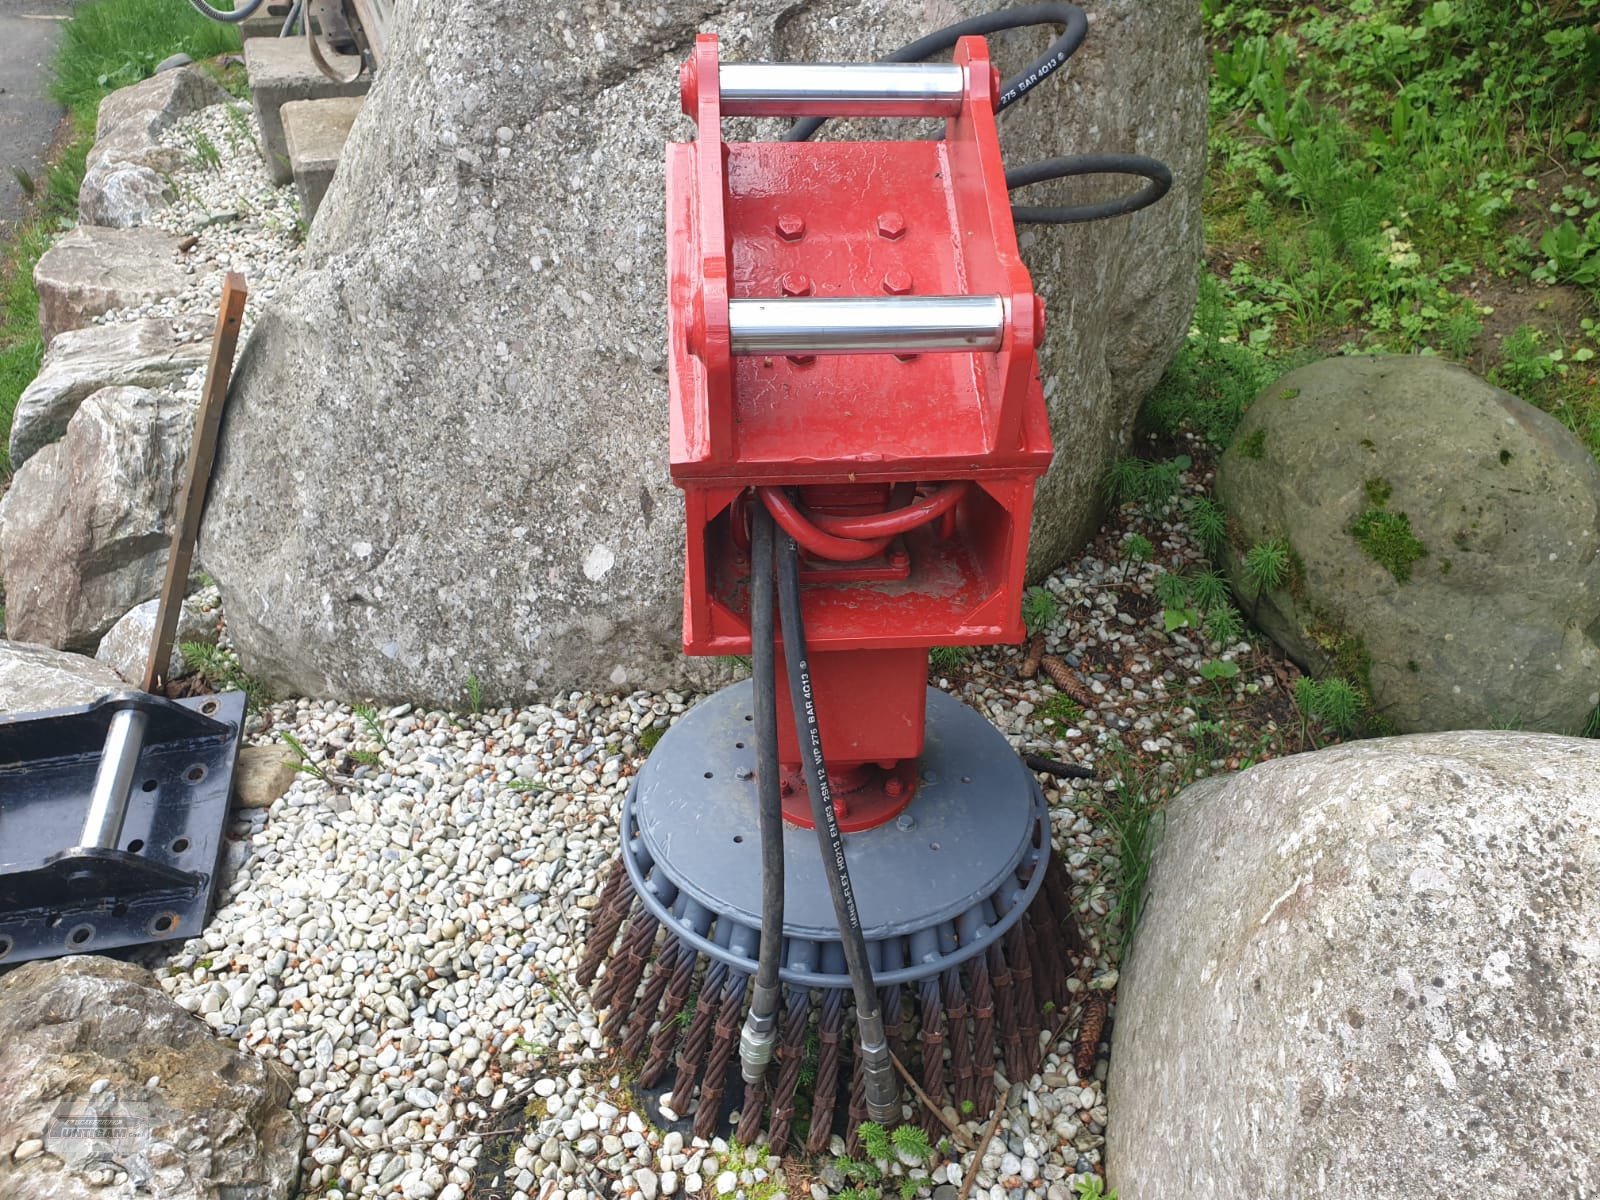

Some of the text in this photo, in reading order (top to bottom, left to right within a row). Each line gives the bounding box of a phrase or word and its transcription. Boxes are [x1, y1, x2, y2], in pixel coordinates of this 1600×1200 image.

[1001, 89, 1017, 104] 275
[1018, 74, 1038, 91] BAR
[805, 701, 816, 724] BAR
[810, 728, 820, 746] 275
[813, 748, 822, 765] WP
[817, 768, 826, 781] 12
[820, 783, 830, 802] 2SN
[825, 805, 835, 823] 853
[828, 824, 838, 838] EN
